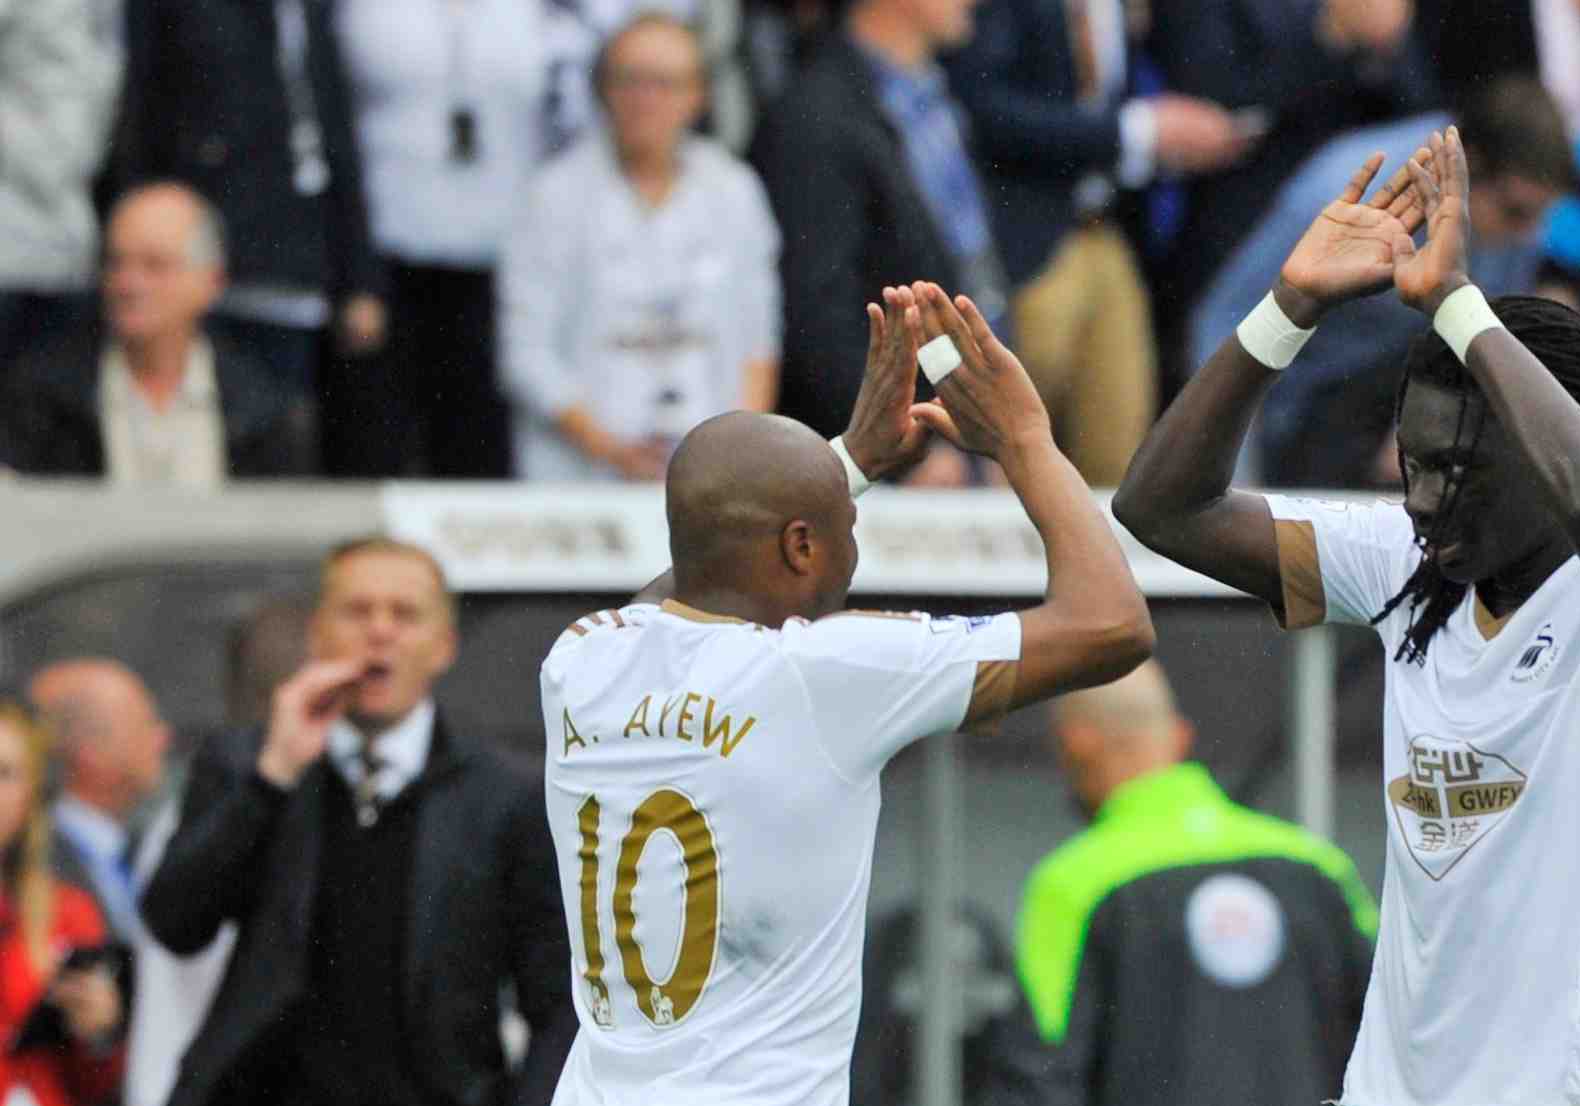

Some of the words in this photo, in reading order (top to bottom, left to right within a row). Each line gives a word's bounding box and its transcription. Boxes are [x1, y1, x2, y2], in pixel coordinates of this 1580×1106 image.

[563, 705, 600, 757] A.
[622, 690, 757, 759] AYEW
[576, 785, 722, 1031] 10
